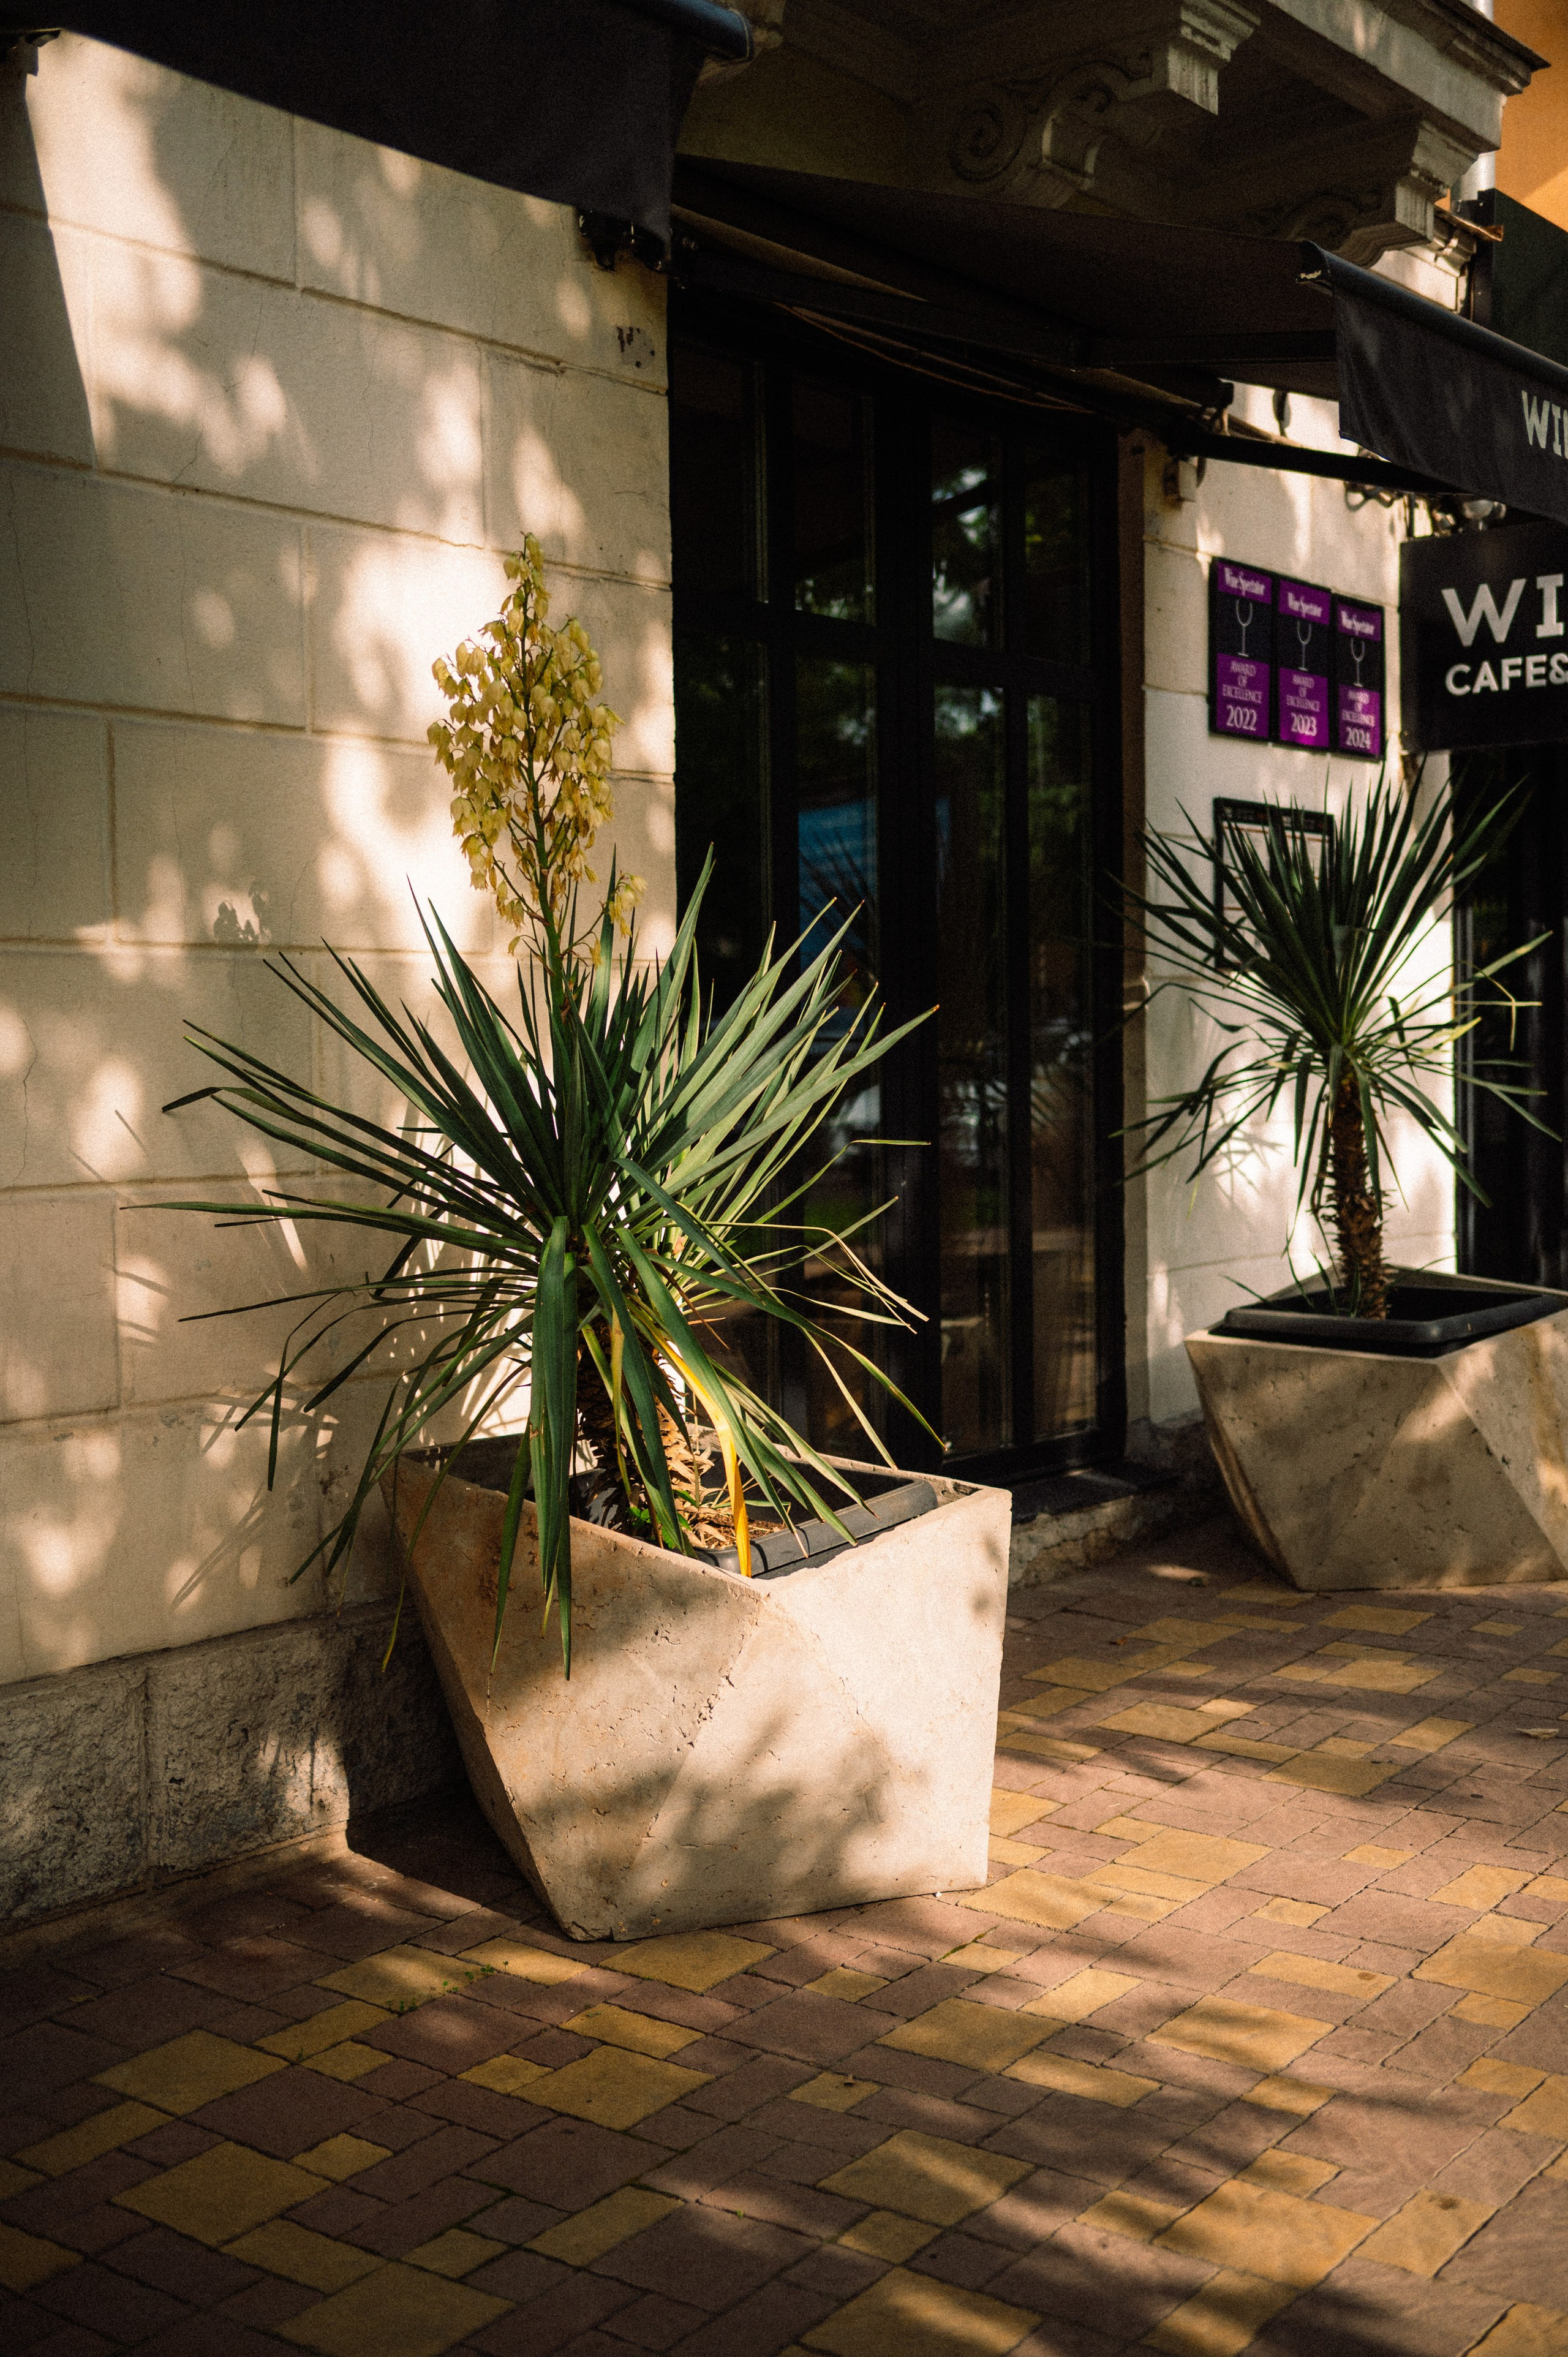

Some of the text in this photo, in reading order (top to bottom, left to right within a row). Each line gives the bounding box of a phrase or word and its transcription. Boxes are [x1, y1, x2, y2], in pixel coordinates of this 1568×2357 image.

[1238, 674, 1248, 688] OF
[1223, 684, 1262, 704] EXCELLENCE
[1226, 705, 1257, 731] 2022
[1291, 712, 1317, 737] 2023
[1346, 726, 1371, 749] 2024
